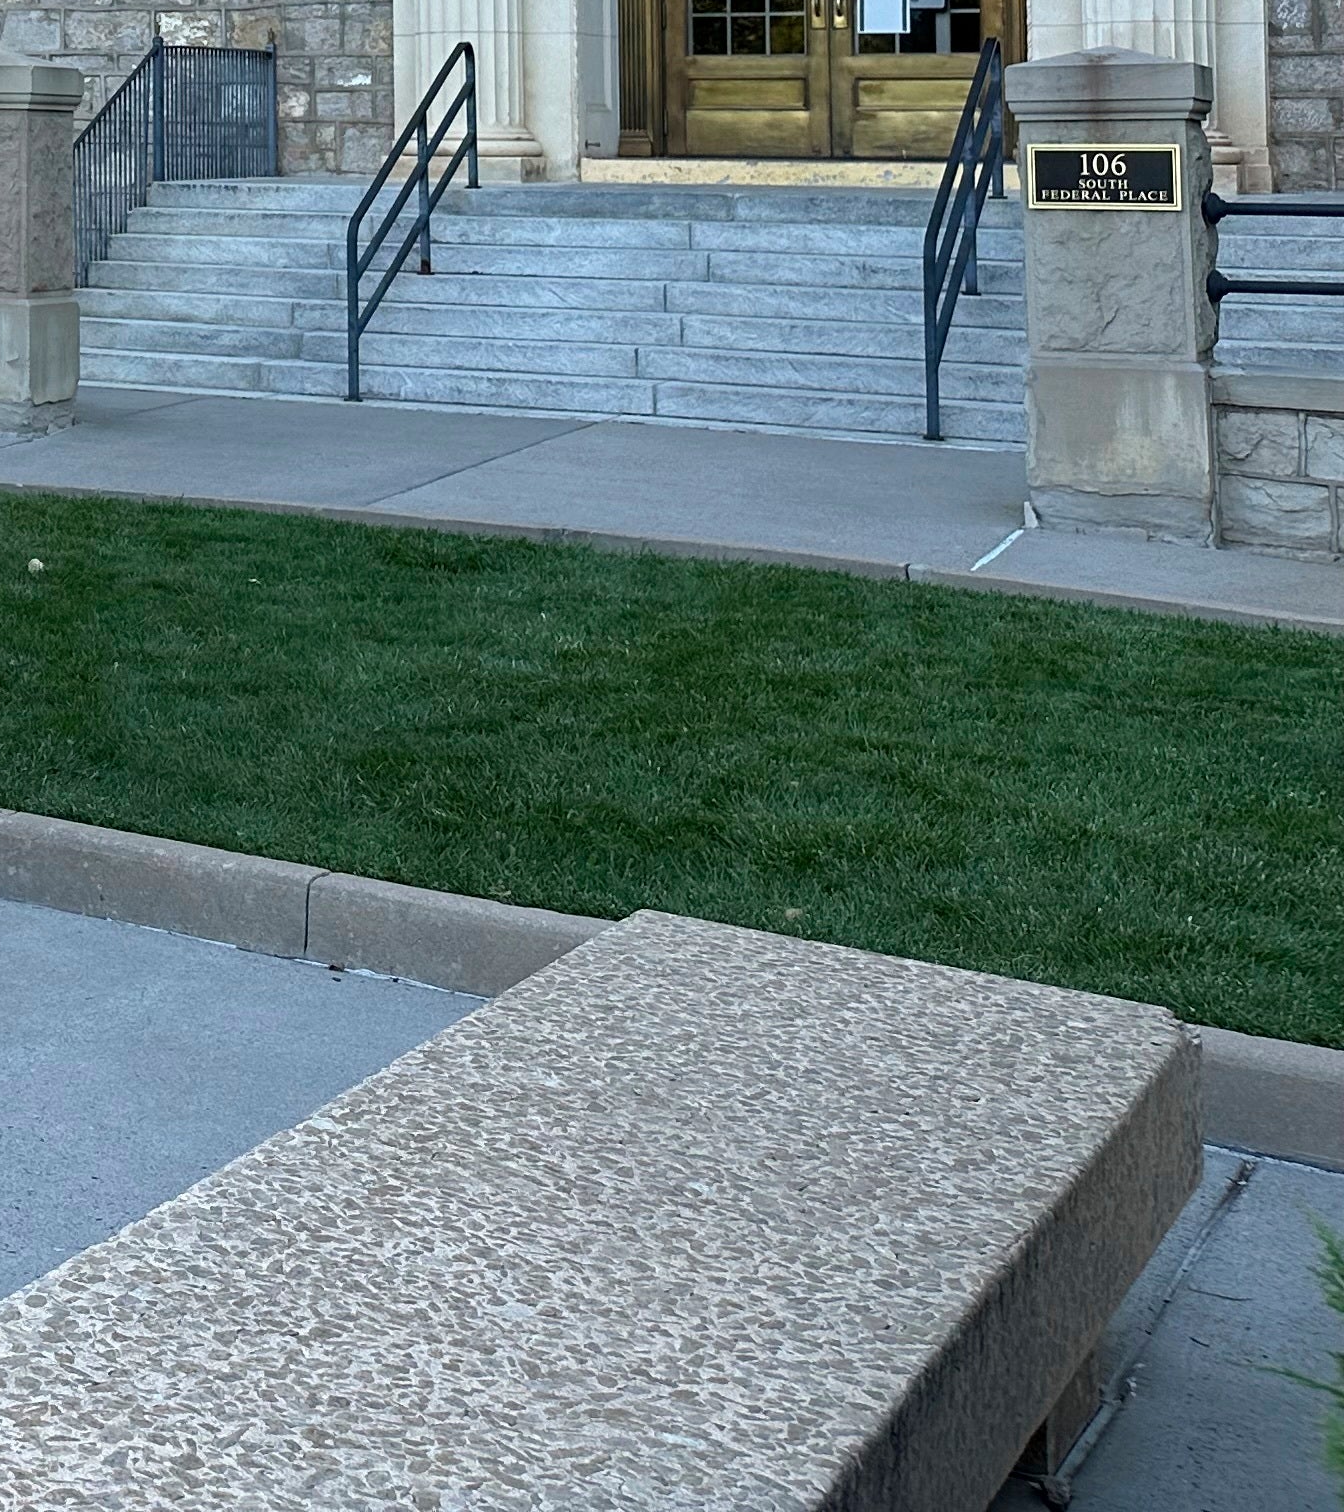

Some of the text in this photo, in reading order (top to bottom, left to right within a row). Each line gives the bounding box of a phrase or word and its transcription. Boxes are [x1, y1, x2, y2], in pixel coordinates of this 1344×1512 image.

[1079, 153, 1126, 176] 106
[1078, 178, 1128, 189] SOUTH
[1041, 189, 1169, 201] FEDERAL PLACE
